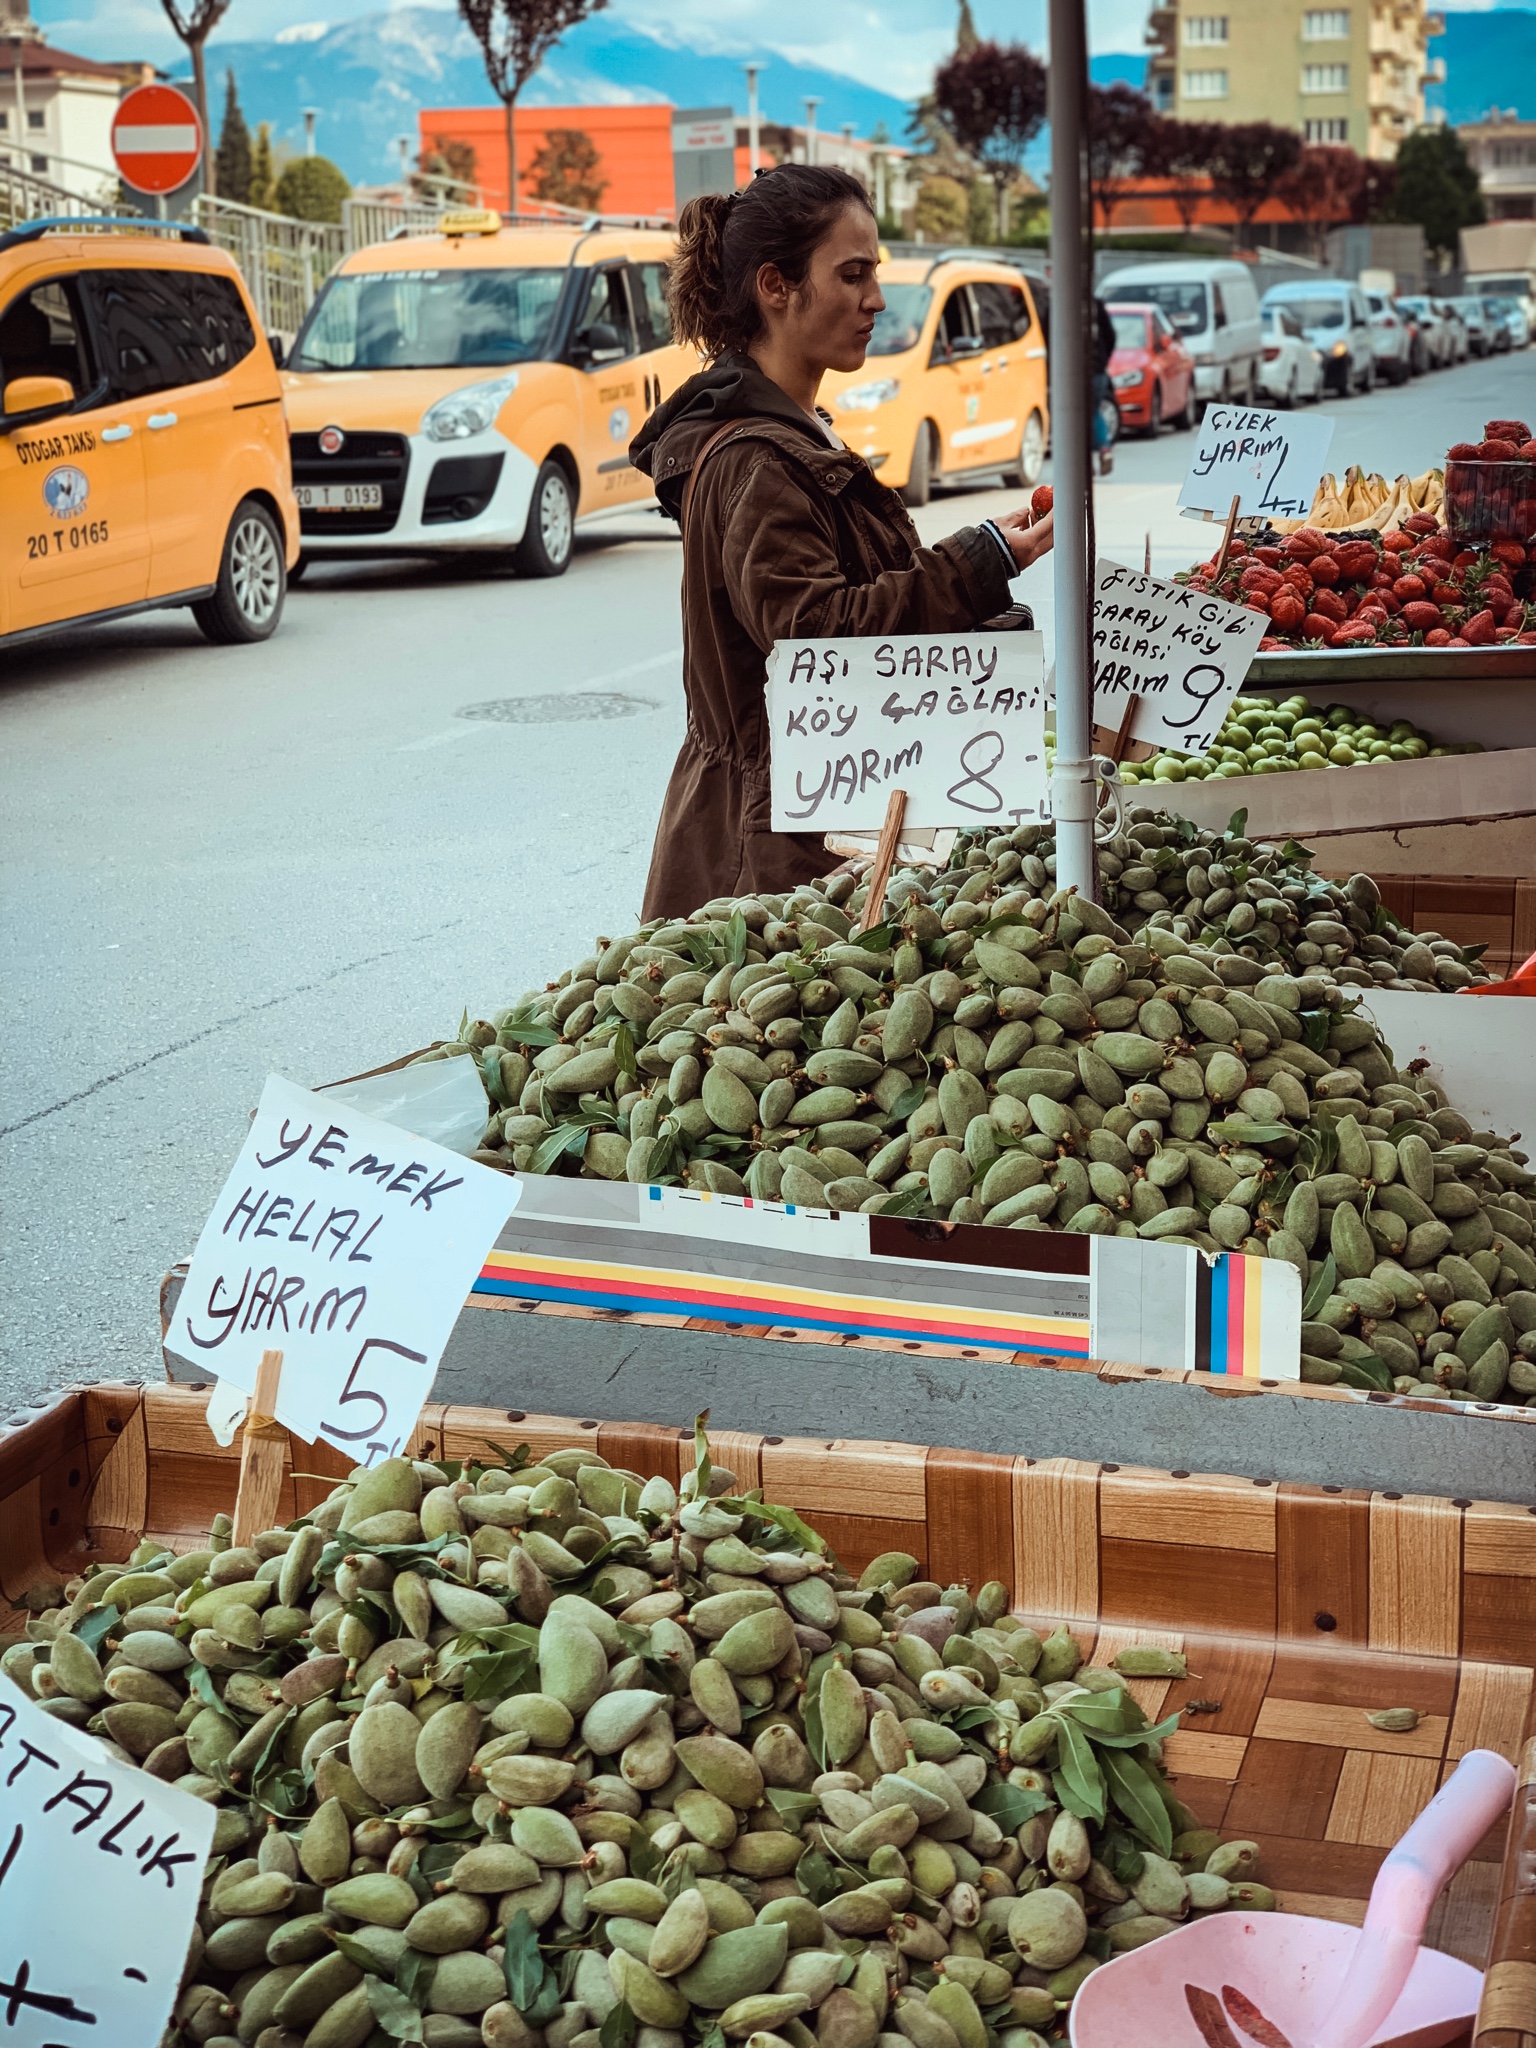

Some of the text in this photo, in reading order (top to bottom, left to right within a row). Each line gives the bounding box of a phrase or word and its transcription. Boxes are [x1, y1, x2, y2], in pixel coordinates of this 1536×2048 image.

[16, 437, 65, 465] OTOGAR
[296, 487, 380, 505] 20 T 0193
[1281, 500, 1308, 517] TL
[27, 520, 108, 559] 20 T 0165
[874, 643, 998, 686] SARAY
[786, 696, 857, 737] KÖY
[1183, 732, 1212, 750] TL
[222, 1186, 383, 1262] HELAL
[319, 1338, 428, 1441] 5
